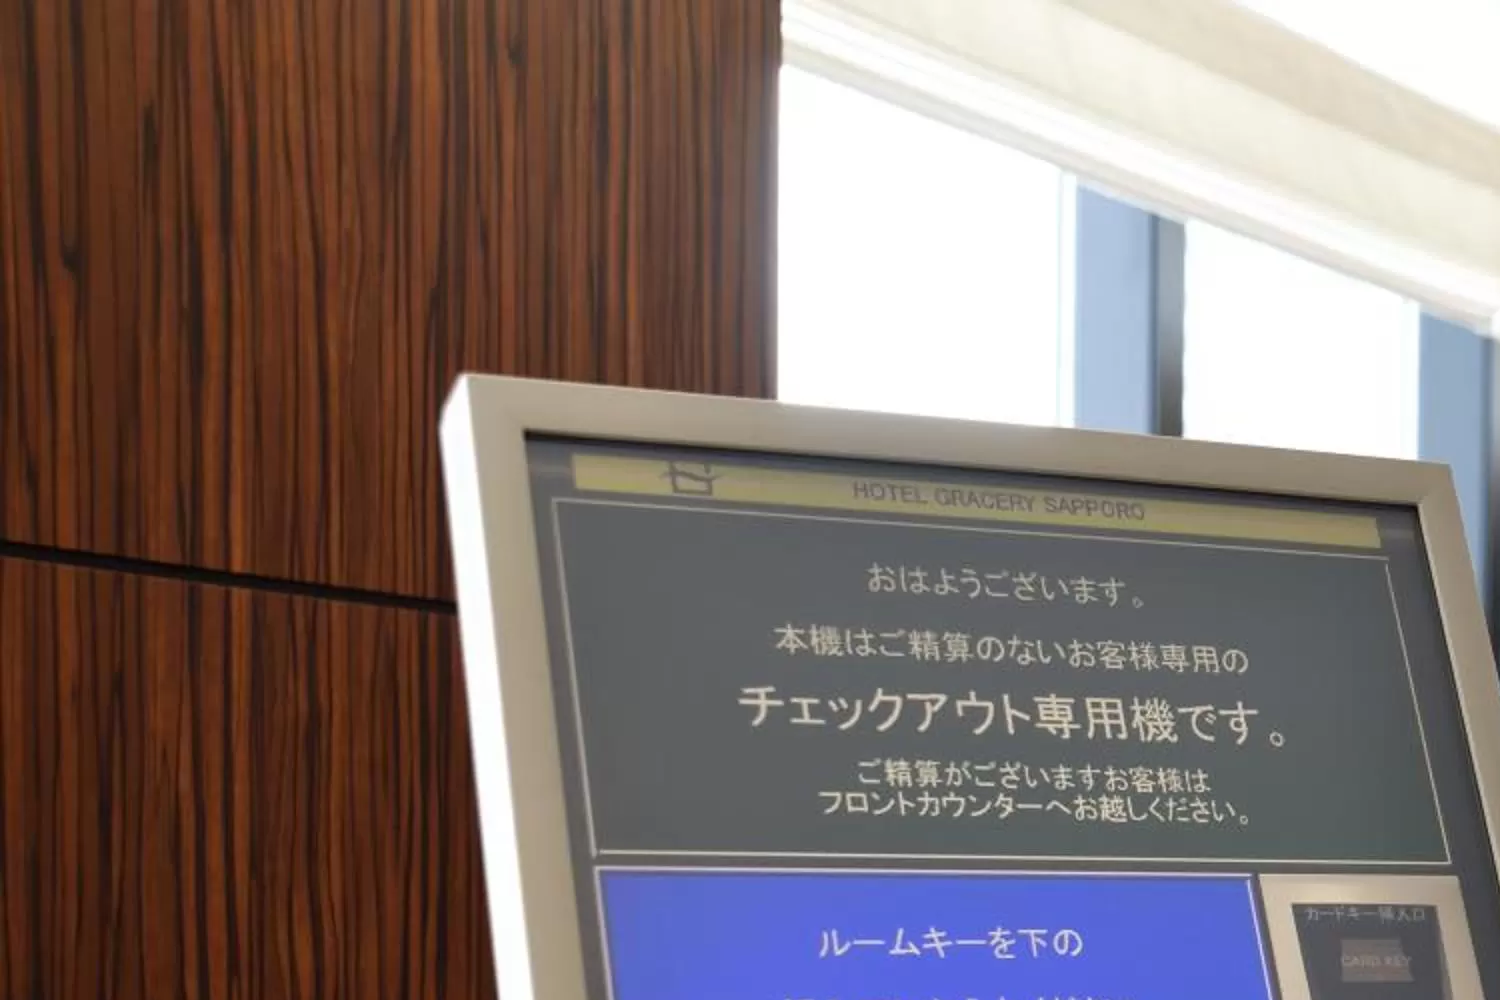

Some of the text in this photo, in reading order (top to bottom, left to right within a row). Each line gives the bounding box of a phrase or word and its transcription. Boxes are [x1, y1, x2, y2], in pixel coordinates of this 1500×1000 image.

[852, 481, 1146, 521] HOTEL GRACERY SAPPORO
[866, 561, 1145, 609] おはようございます。
[773, 623, 1249, 674] 本機はご精算のないお客様専用の
[737, 685, 1286, 748] チェックアウト専用機です。
[857, 758, 1212, 795] ご精算がございますお客様は
[818, 790, 1250, 827] フロントカウンターへお越しください。
[817, 925, 1083, 962] ルームキーを下の
